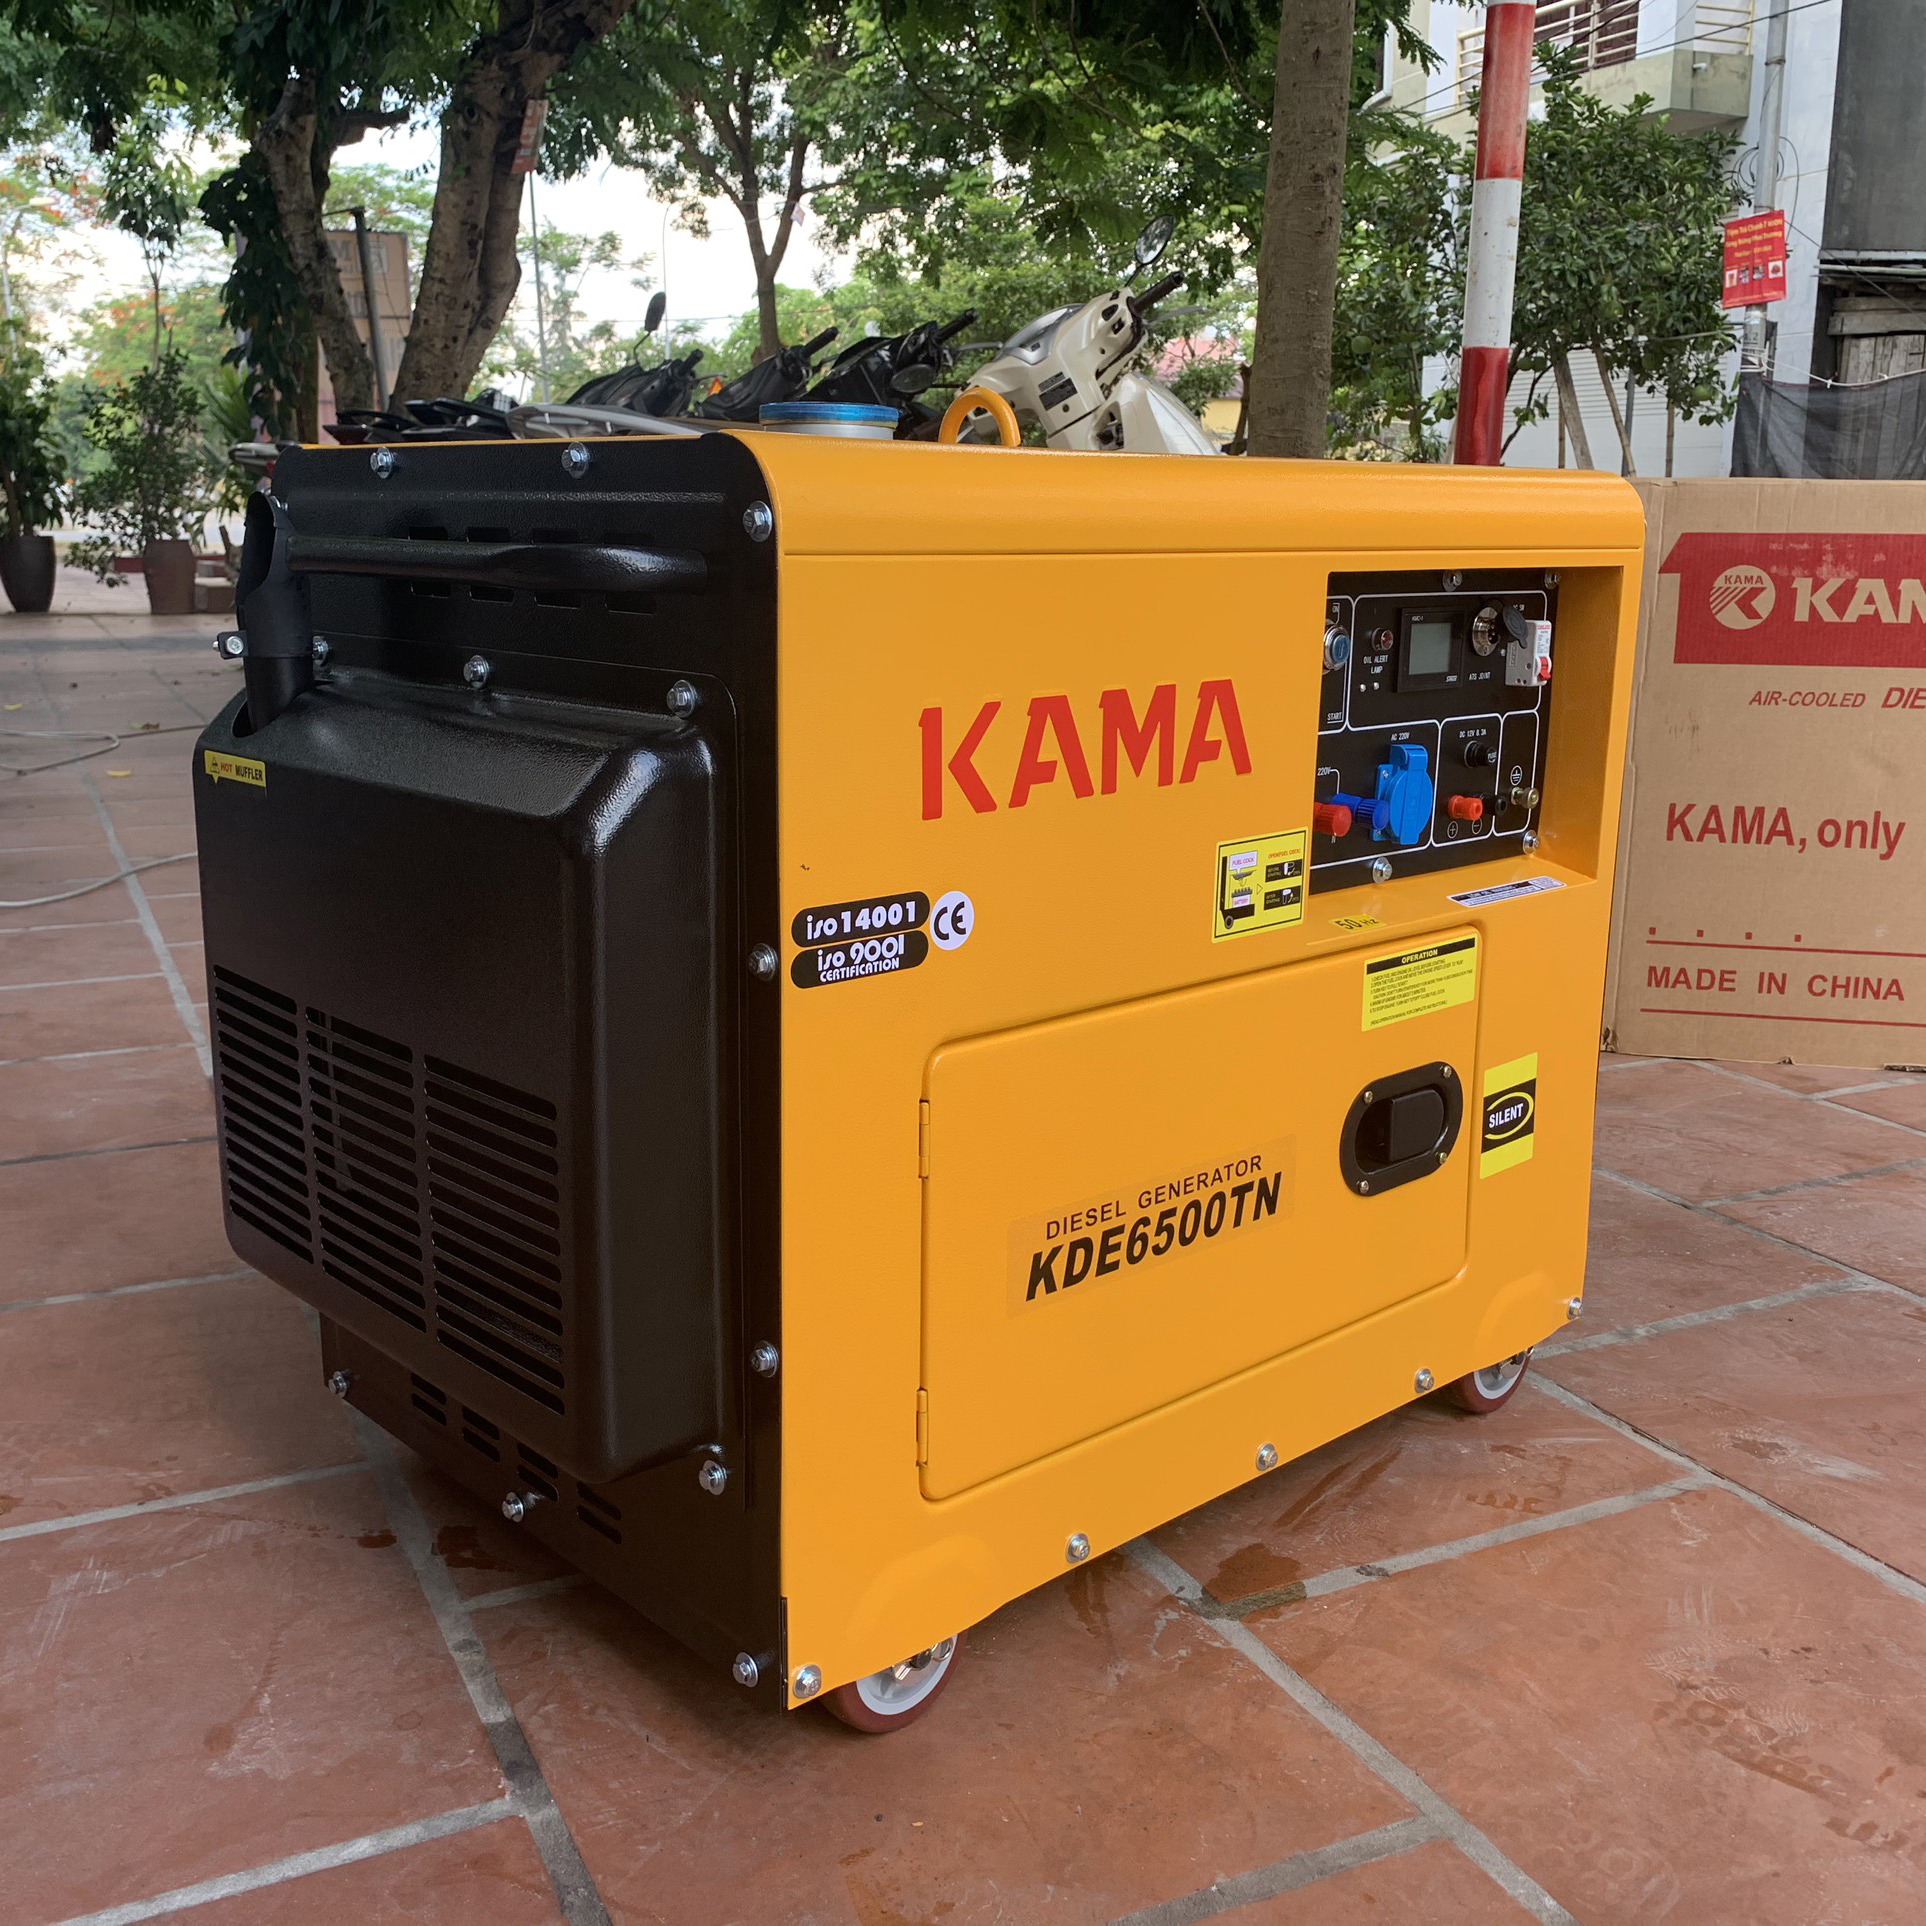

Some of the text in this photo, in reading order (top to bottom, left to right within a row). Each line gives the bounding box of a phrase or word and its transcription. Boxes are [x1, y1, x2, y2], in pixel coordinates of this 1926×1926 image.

[1724, 575, 1764, 585] KAMA
[1363, 655, 1388, 664] OIL ALERT
[1370, 666, 1383, 674] LAMP
[1749, 691, 1866, 708] AIR-COOLED
[1327, 712, 1342, 720] START
[918, 678, 1252, 821] KAMA
[235, 764, 263, 781] MUFFLER
[1666, 803, 1906, 861] KAMA, only
[934, 902, 966, 940] CE
[1335, 919, 1362, 929] 50
[850, 934, 904, 964] 9001
[1401, 948, 1438, 964] OPERATION
[820, 958, 899, 982] CERTIFICATION
[1647, 966, 1904, 1001] MADE IN CHINA
[1489, 1103, 1523, 1128] SILENT
[1047, 1154, 1262, 1240] DIESEL GENERATOR
[1025, 1171, 1282, 1302] KDE6500TN
